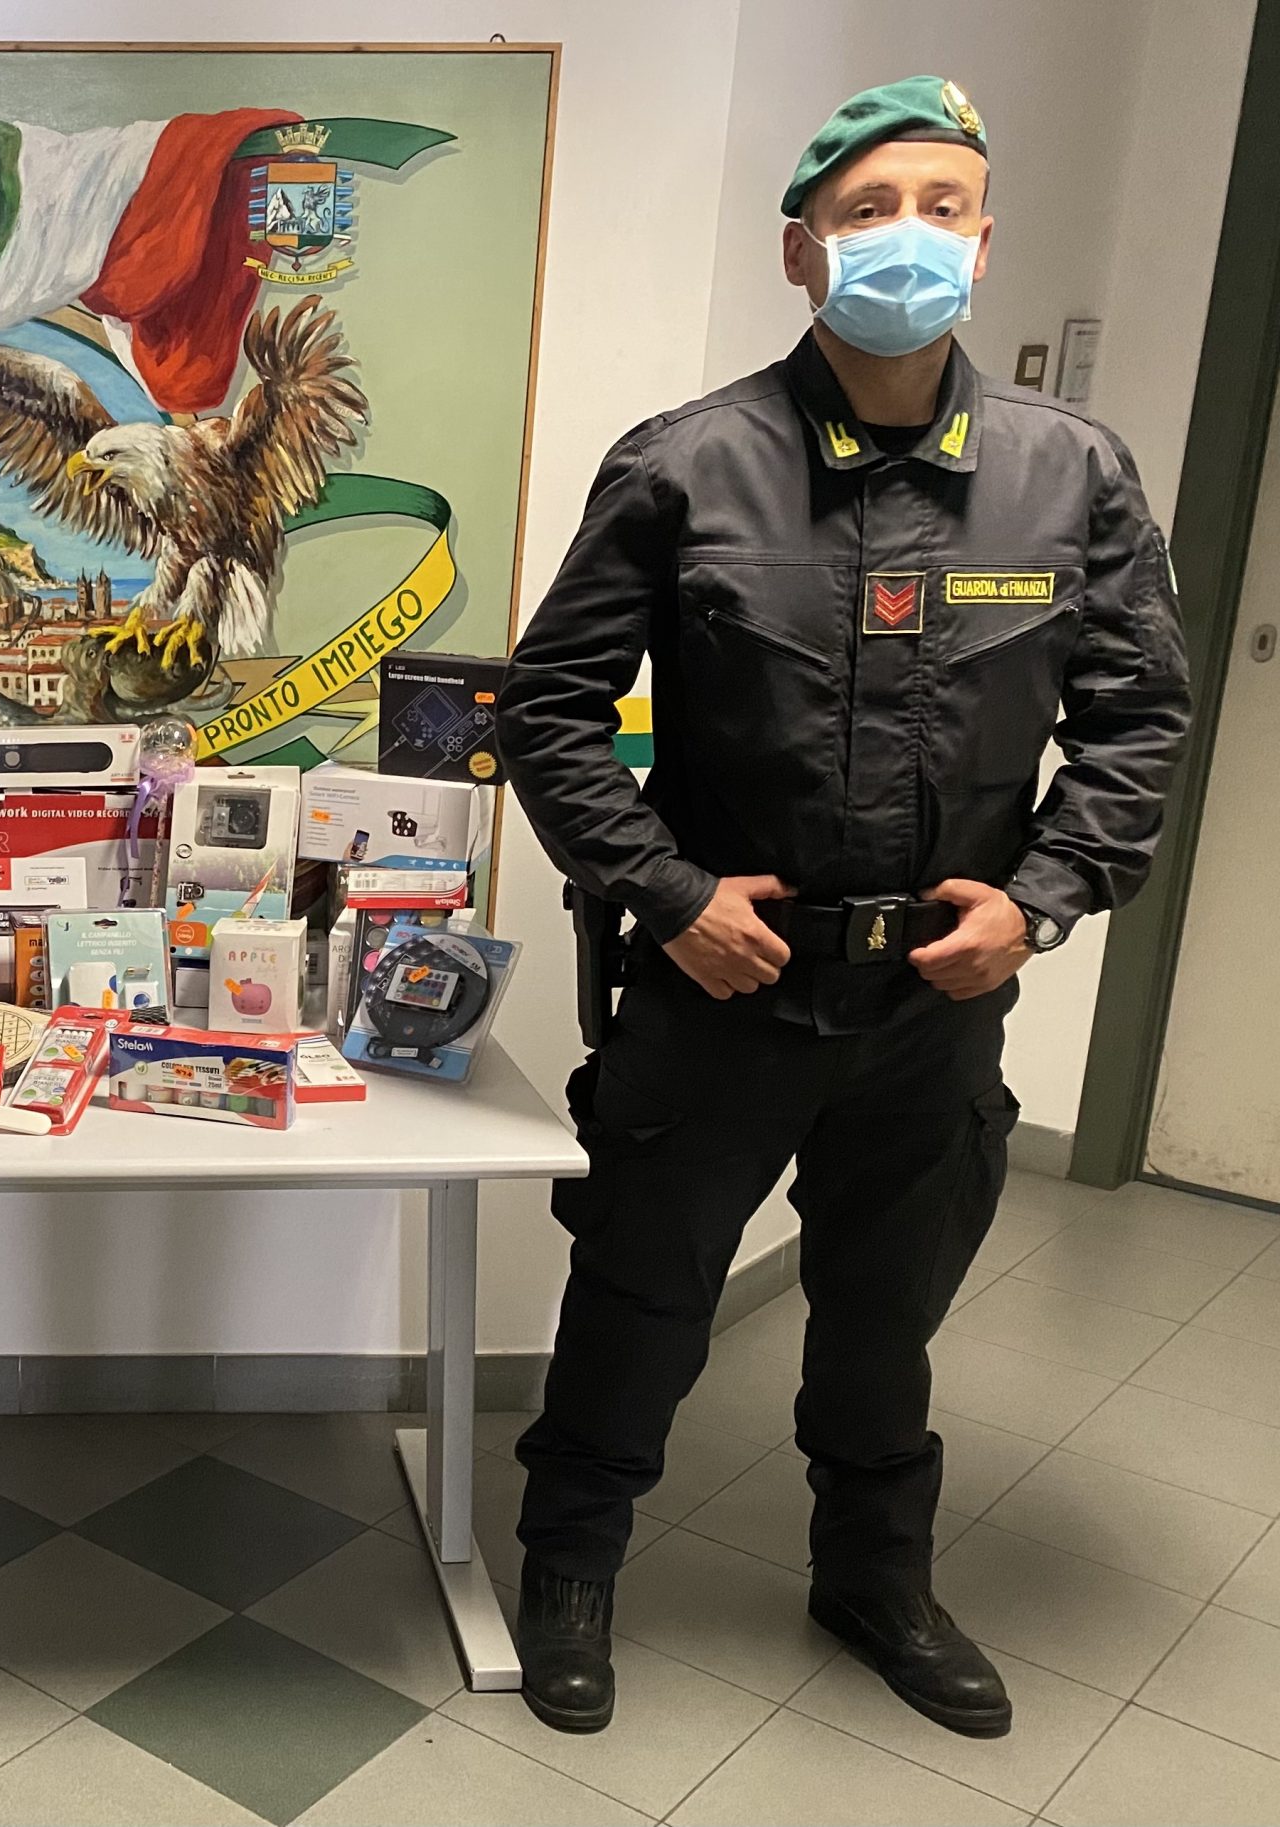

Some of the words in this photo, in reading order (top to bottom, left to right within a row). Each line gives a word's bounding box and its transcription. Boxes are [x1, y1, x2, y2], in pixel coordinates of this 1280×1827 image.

[952, 580, 998, 597] GUARDIA
[1000, 582, 1009, 597] di
[1009, 580, 1048, 597] FINANZA
[203, 680, 300, 750] PRONTO
[311, 589, 422, 692] IMPIEGO
[31, 809, 66, 818] DIGITAL
[68, 810, 94, 818] VIDEO
[228, 950, 277, 964] APPLE
[195, 1065, 220, 1075] TESSUTI
